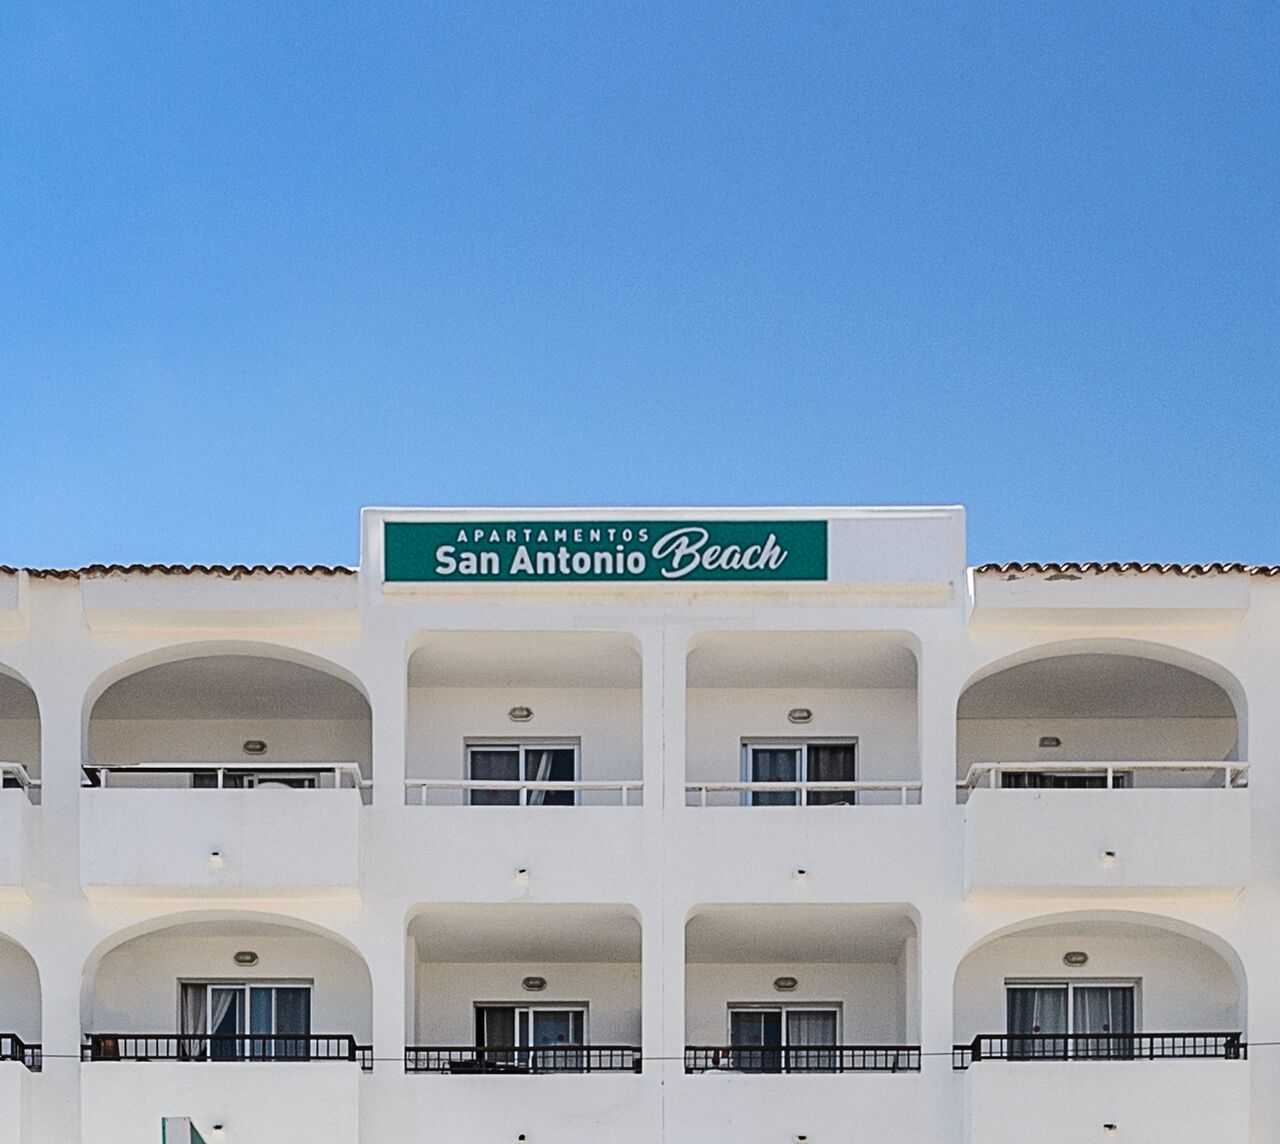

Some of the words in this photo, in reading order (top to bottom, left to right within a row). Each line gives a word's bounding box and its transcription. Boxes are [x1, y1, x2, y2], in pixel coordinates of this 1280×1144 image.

[435, 546, 500, 575] San
[509, 545, 646, 576] Antonio
[651, 526, 788, 578] Beach
[457, 528, 650, 543] APARTAMENTOS
